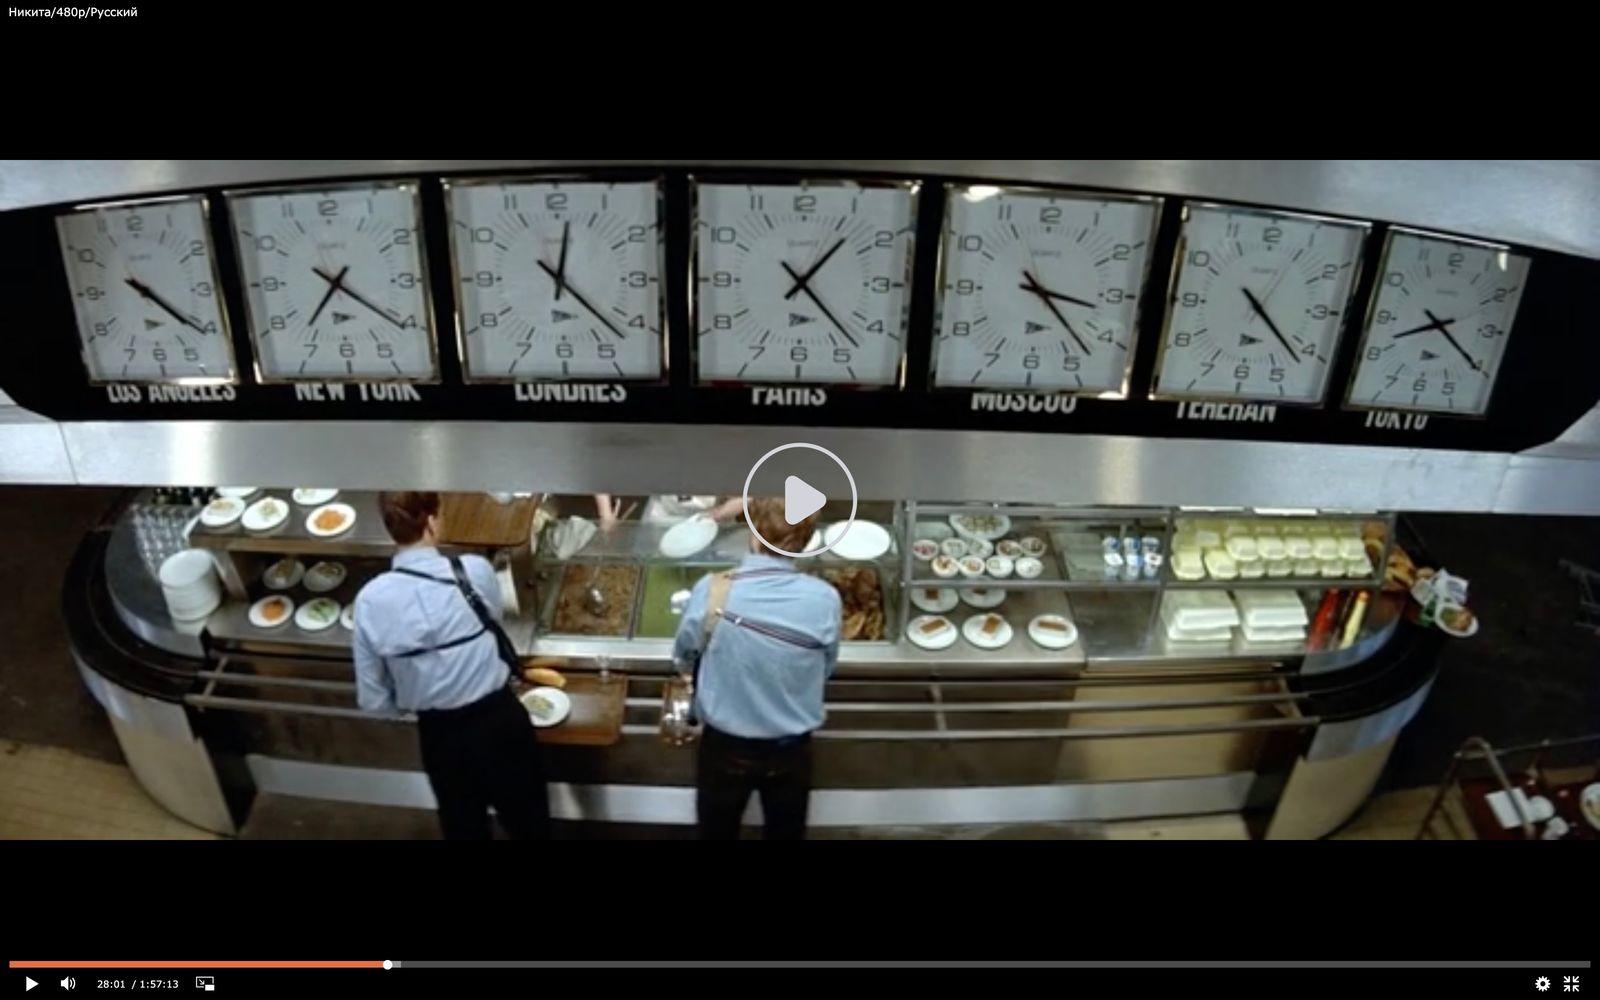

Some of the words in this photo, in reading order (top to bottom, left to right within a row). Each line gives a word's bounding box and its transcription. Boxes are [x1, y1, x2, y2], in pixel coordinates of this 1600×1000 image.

[318, 200, 338, 216] 12
[367, 199, 372, 213] 1
[504, 194, 517, 210] 11
[545, 193, 568, 210] 12
[602, 194, 607, 210] 1
[750, 195, 763, 210] 11
[793, 195, 816, 212] 12
[853, 198, 857, 213] 1
[282, 202, 293, 217] 11
[998, 205, 1011, 220] 11
[1040, 207, 1062, 224] 12
[126, 216, 143, 231] 12
[167, 214, 172, 227] 1
[1094, 211, 1099, 226] 1
[394, 229, 409, 245] 2
[470, 229, 494, 243] 10
[628, 226, 645, 242] 2
[711, 227, 736, 243] 10
[1227, 223, 1239, 237] 11
[1263, 227, 1282, 243] 12
[875, 231, 893, 247] 2
[958, 235, 982, 251] 10
[1309, 233, 1314, 247] 1
[190, 240, 204, 256] 2
[1113, 244, 1130, 260] 2
[1188, 251, 1209, 267] 10
[1448, 253, 1464, 268] 12
[1486, 259, 1490, 271] 1
[1322, 264, 1337, 279] 2
[263, 277, 278, 291] 9
[399, 273, 415, 288] 3
[477, 272, 493, 287] 9
[628, 272, 647, 288] 3
[713, 272, 731, 287] 9
[871, 277, 890, 293] 3
[87, 287, 98, 300] 9
[197, 282, 211, 297] 3
[957, 280, 973, 295] 9
[1494, 288, 1507, 302] 2
[1106, 289, 1123, 304] 3
[1182, 293, 1197, 307] 9
[1312, 305, 1328, 320] 3
[1377, 310, 1391, 324] 9
[271, 316, 285, 329] 8
[402, 315, 416, 329] 4
[481, 313, 497, 328] 8
[628, 315, 645, 329] 4
[714, 315, 731, 329] 8
[867, 320, 884, 334] 4
[95, 323, 108, 336] 8
[953, 322, 969, 336] 8
[1098, 329, 1113, 343] 4
[1482, 324, 1496, 338] 3
[1175, 333, 1191, 347] 8
[124, 349, 136, 361] 7
[153, 349, 167, 361] 6
[184, 349, 198, 361] 5
[304, 344, 317, 358] 7
[340, 344, 355, 358] 6
[377, 344, 393, 358] 5
[517, 342, 532, 357] 7
[556, 344, 573, 358] 6
[597, 344, 615, 359] 5
[750, 347, 765, 360] 7
[791, 347, 807, 362] 6
[833, 348, 851, 363] 5
[1302, 343, 1316, 357] 4
[1367, 347, 1380, 361] 8
[984, 352, 1000, 367] 7
[1023, 355, 1039, 370] 6
[1063, 357, 1080, 371] 5
[1202, 363, 1215, 376] 7
[1234, 364, 1249, 379] 6
[1269, 369, 1284, 382] 5
[1386, 376, 1398, 389] 7
[1413, 378, 1426, 392] 6
[1442, 382, 1456, 396] 5
